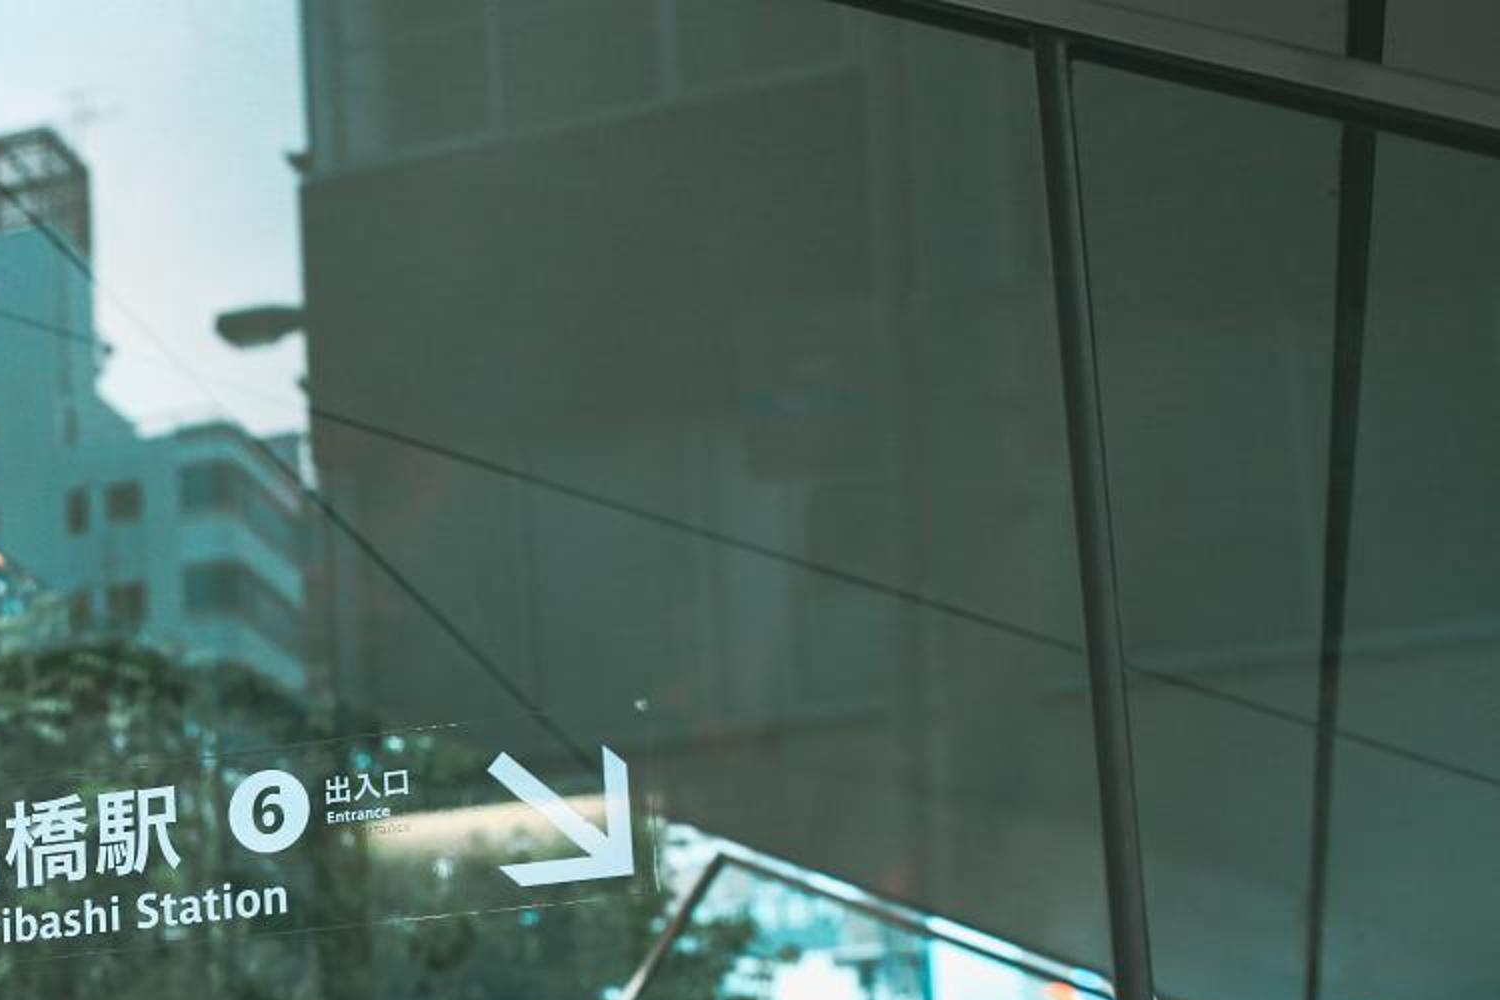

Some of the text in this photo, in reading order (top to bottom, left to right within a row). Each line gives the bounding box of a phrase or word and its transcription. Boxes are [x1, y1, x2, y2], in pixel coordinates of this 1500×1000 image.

[325, 769, 409, 805] 出入口
[252, 785, 286, 835] 6
[326, 806, 392, 825] Entrance
[137, 882, 289, 930] Station
